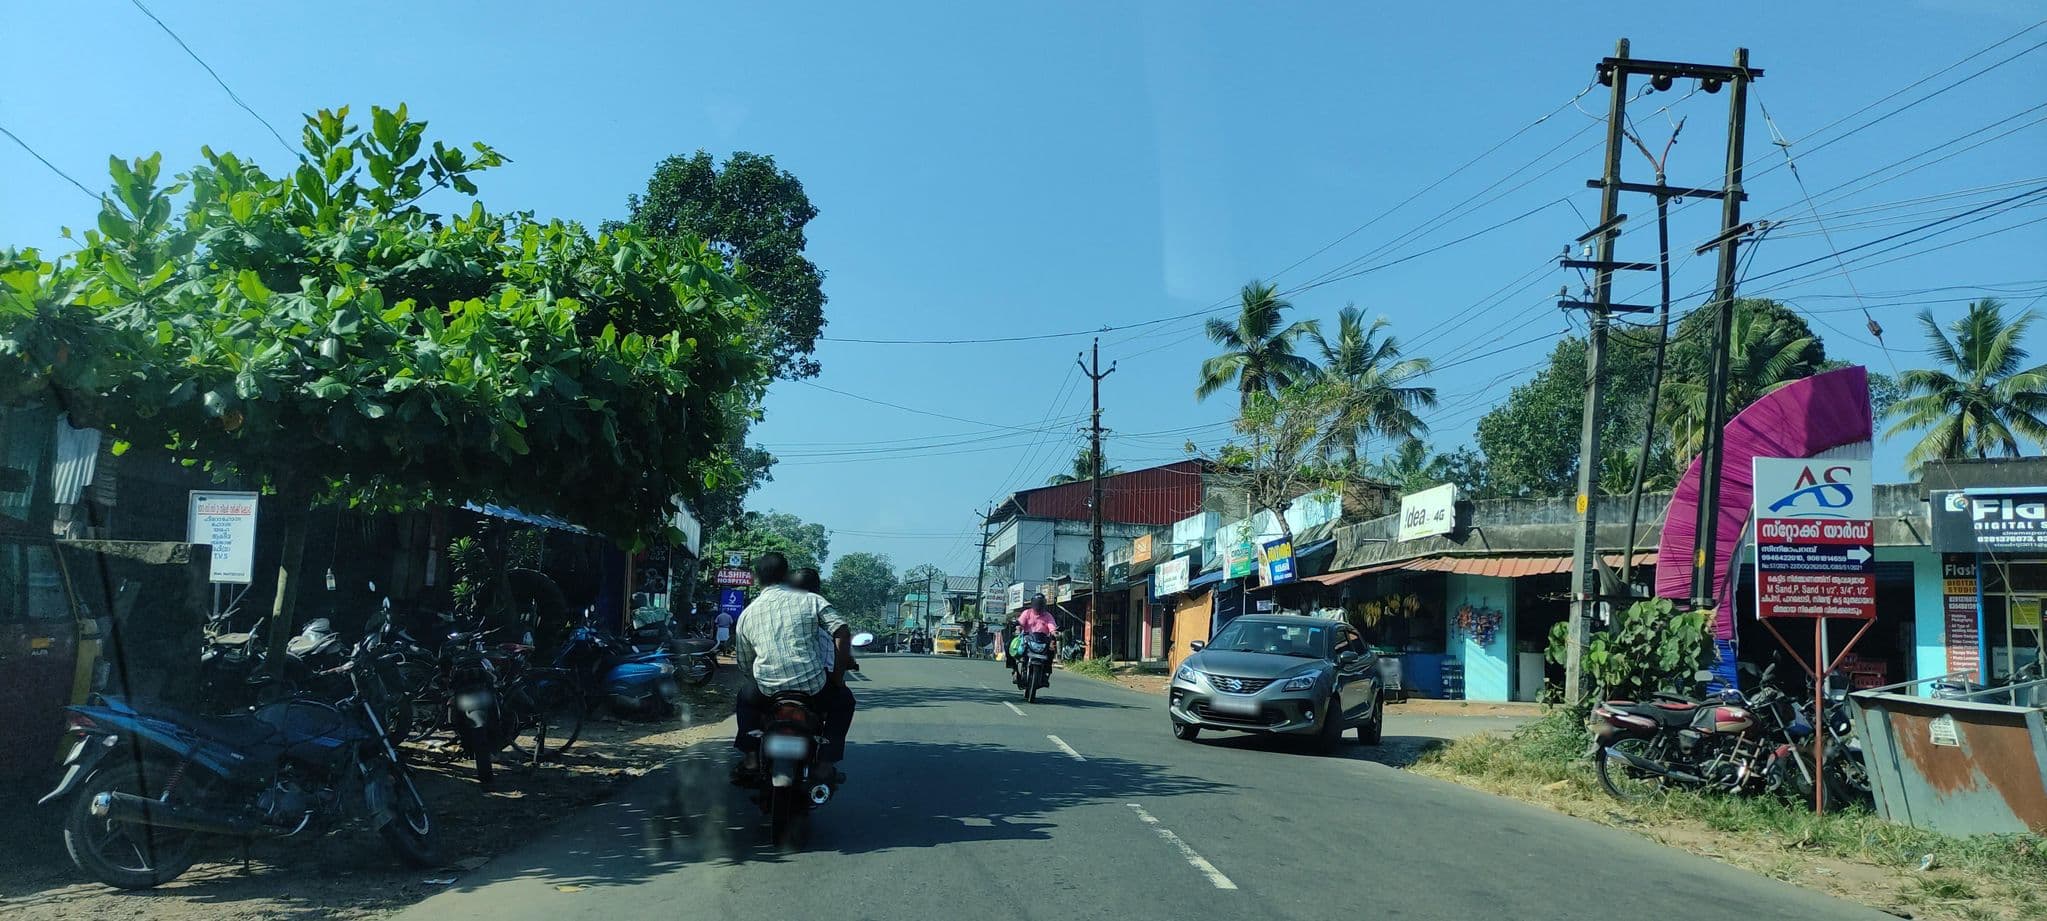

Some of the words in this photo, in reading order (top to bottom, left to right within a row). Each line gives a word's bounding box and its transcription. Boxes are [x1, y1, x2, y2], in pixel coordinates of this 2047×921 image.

[1768, 465, 1853, 513] AS
[1404, 506, 1426, 529] Idea
[1974, 522, 2033, 530] DIGITAL
[717, 571, 751, 579] ALSHIFA
[1767, 585, 1774, 593] M
[1802, 585, 1819, 594] Sand
